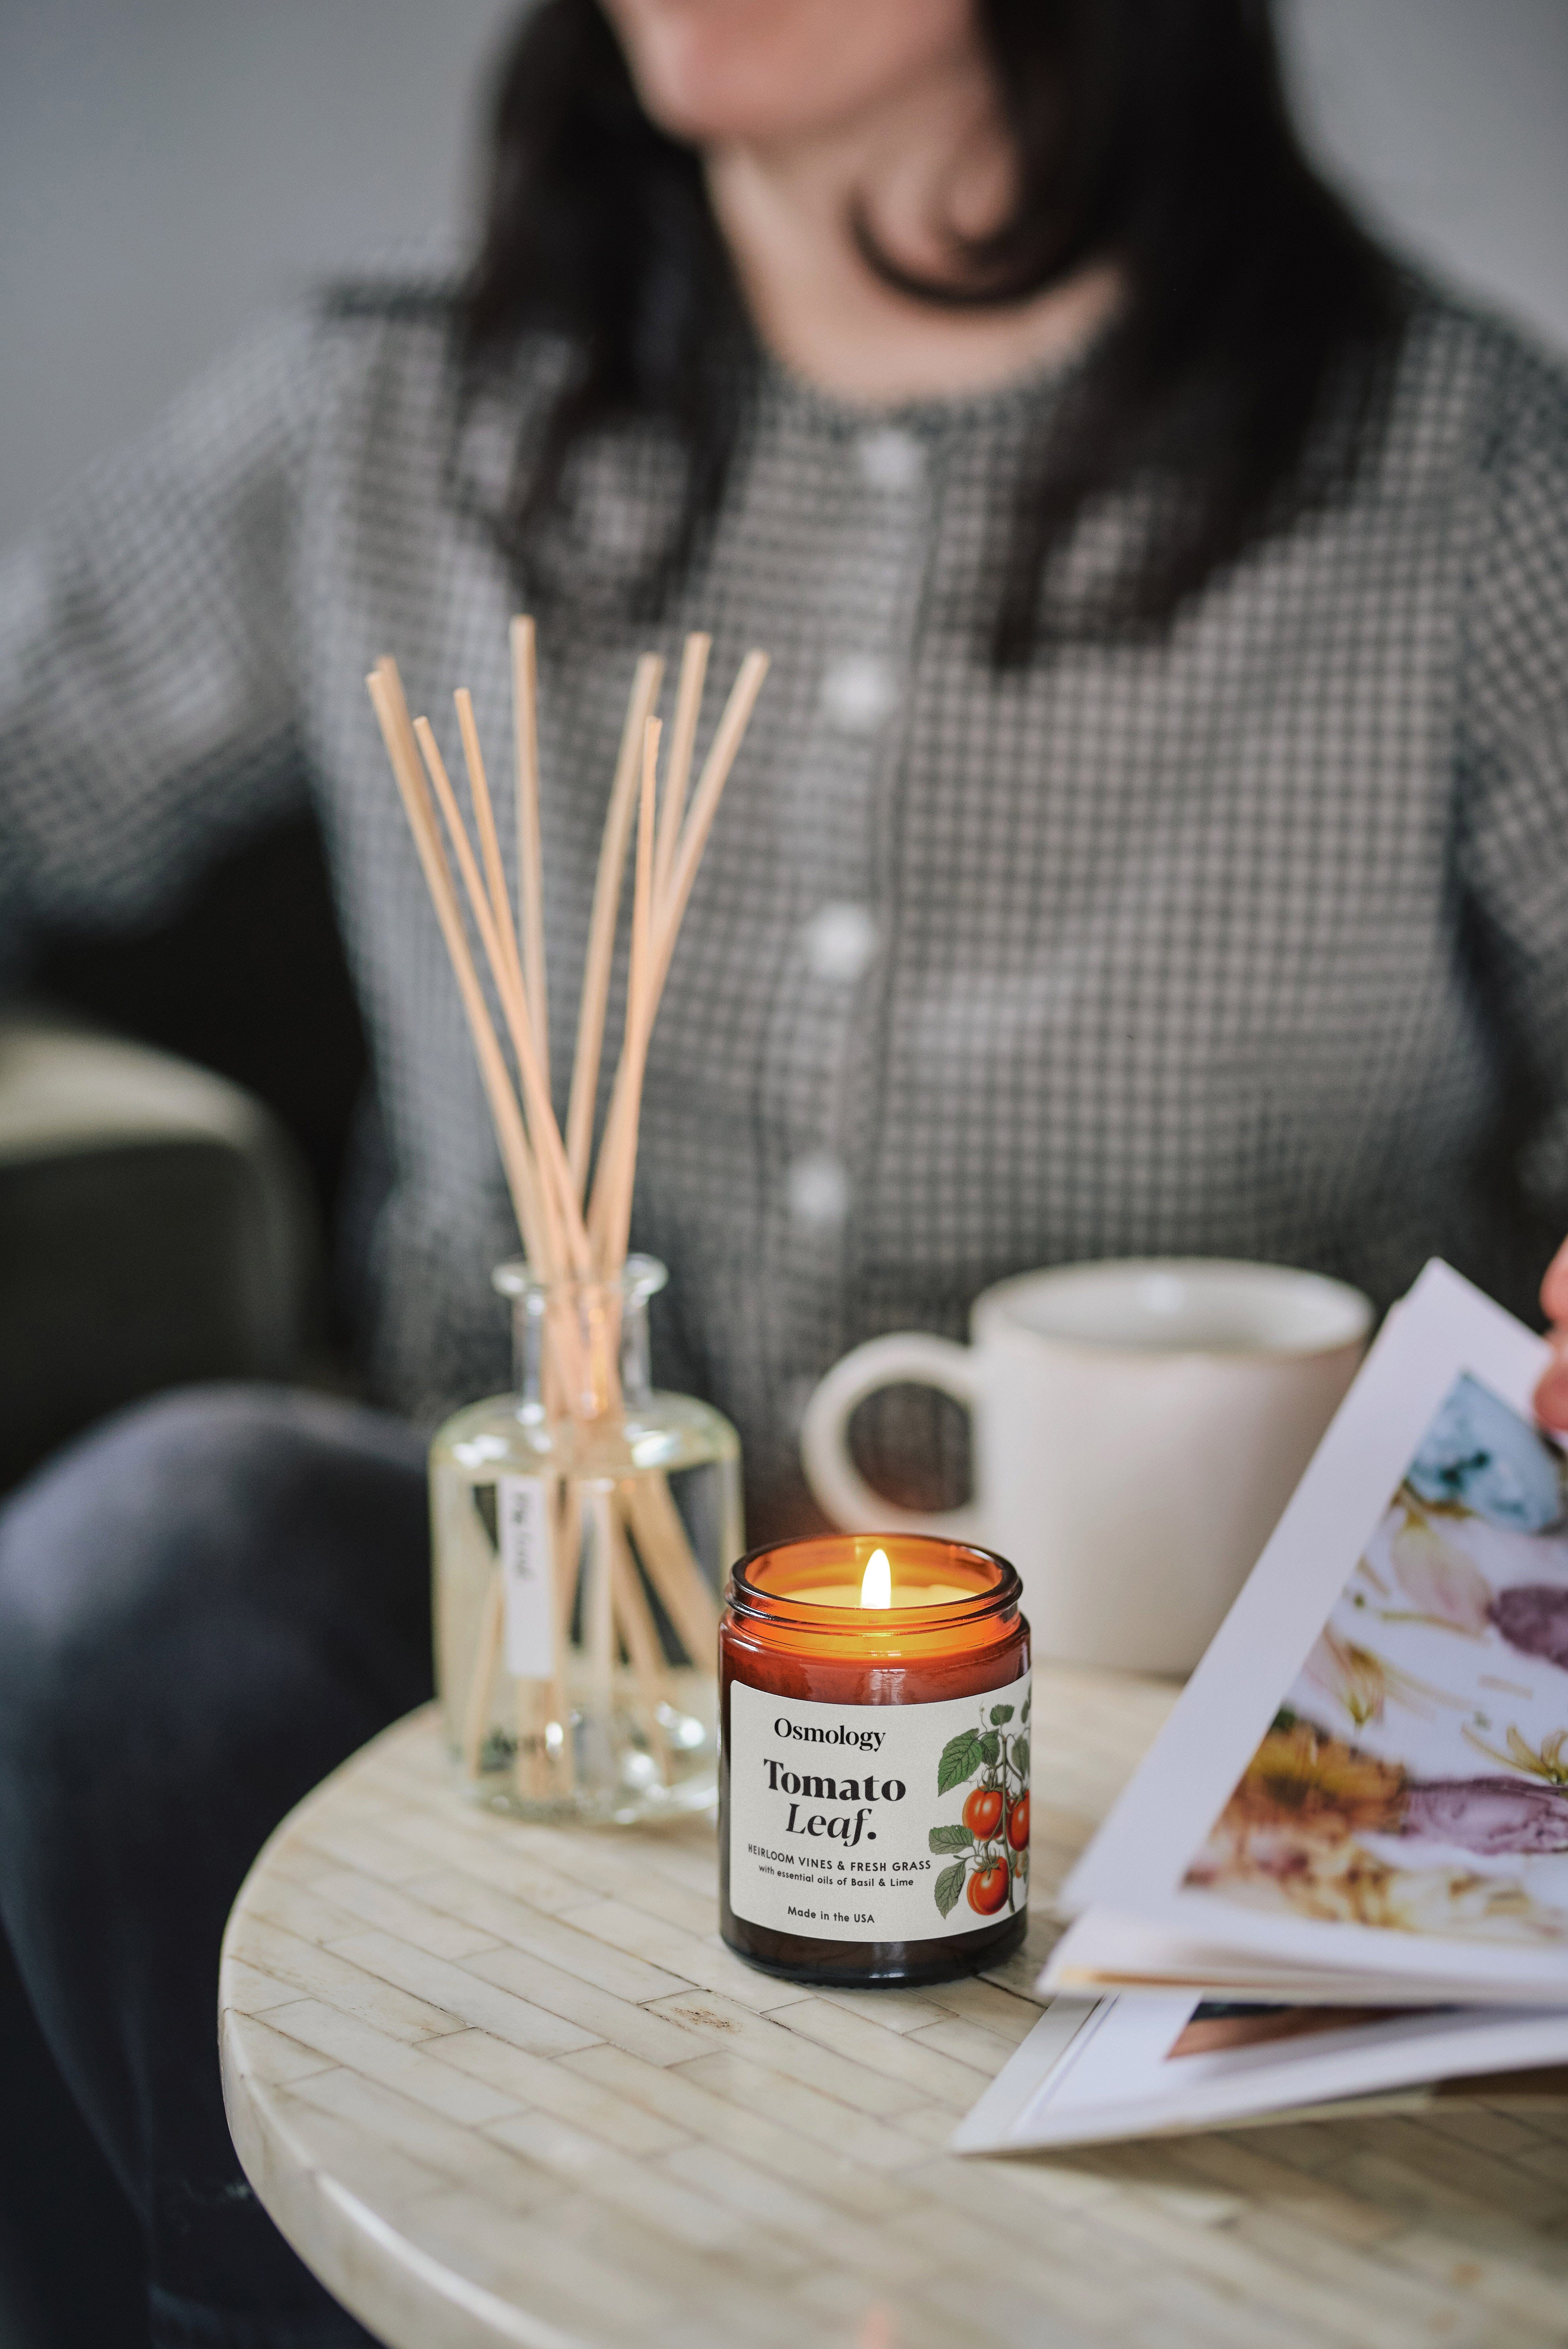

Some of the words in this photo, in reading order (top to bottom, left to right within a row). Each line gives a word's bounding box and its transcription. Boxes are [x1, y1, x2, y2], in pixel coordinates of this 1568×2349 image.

[775, 1718, 886, 1752] Osmology
[763, 1758, 906, 1802] Tomato
[785, 1803, 877, 1847] Leaf.
[748, 1844, 794, 1865] HEIRLOOM
[799, 1857, 832, 1870] VINES
[837, 1861, 845, 1870] &
[850, 1862, 887, 1871] FRESH
[892, 1860, 931, 1871] GRASS
[759, 1865, 775, 1875] with
[777, 1870, 814, 1882] essential
[817, 1876, 833, 1885] oils
[837, 1877, 847, 1886] of
[851, 1878, 874, 1887] Basil
[878, 1878, 886, 1887] &
[788, 1906, 816, 1919] Made
[820, 1910, 829, 1921] in
[833, 1912, 850, 1922] the
[854, 1914, 875, 1924] USA
